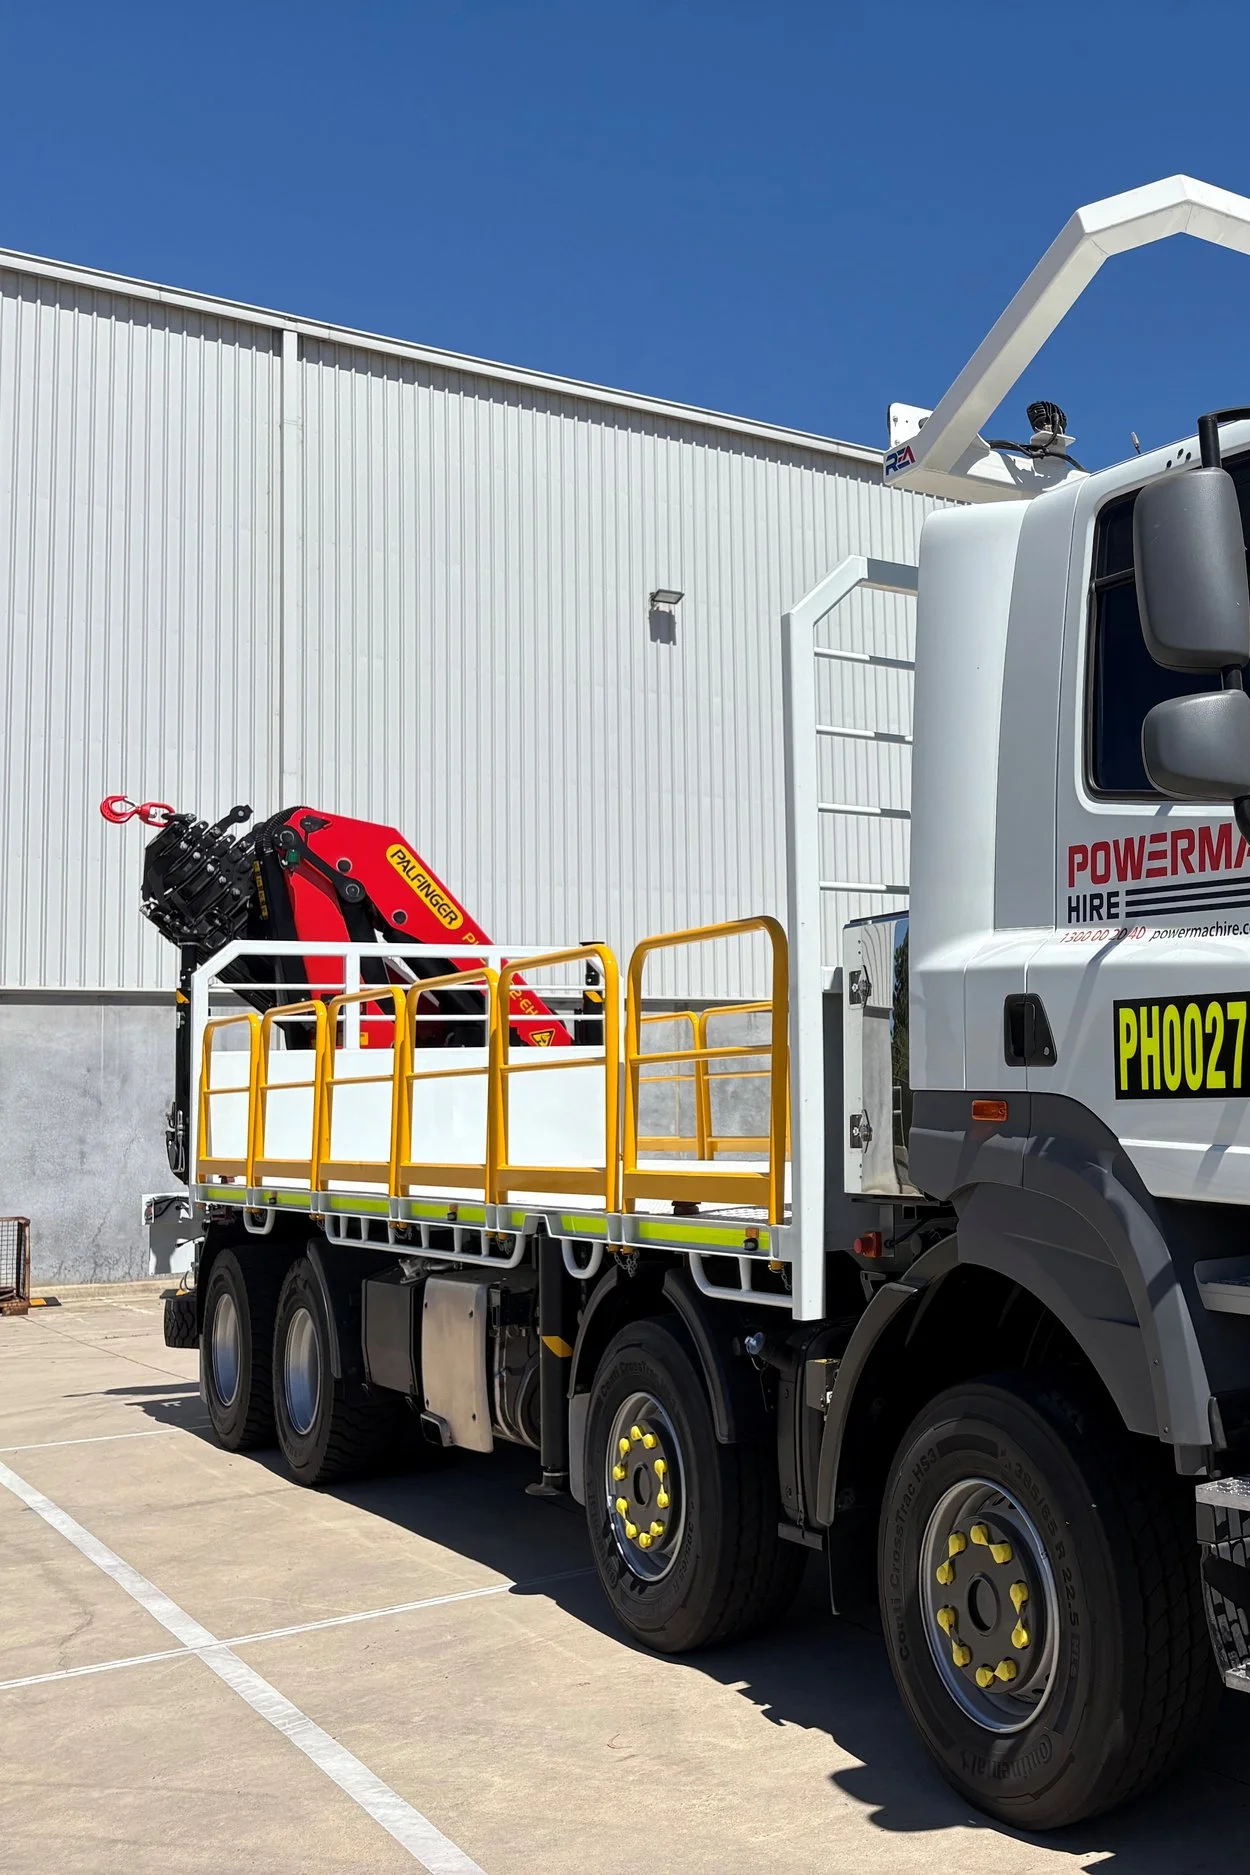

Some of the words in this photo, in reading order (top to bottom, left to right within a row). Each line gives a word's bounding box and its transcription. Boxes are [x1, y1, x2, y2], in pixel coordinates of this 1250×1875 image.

[390, 848, 459, 926] PALFINGER
[1067, 891, 1120, 924] HIRE
[1059, 931, 1092, 943] 1300
[1091, 929, 1110, 941] 00
[1109, 927, 1128, 941] 20
[1128, 926, 1147, 940] 40
[1118, 1001, 1248, 1092] PH0027
[911, 1447, 938, 1483] HS3
